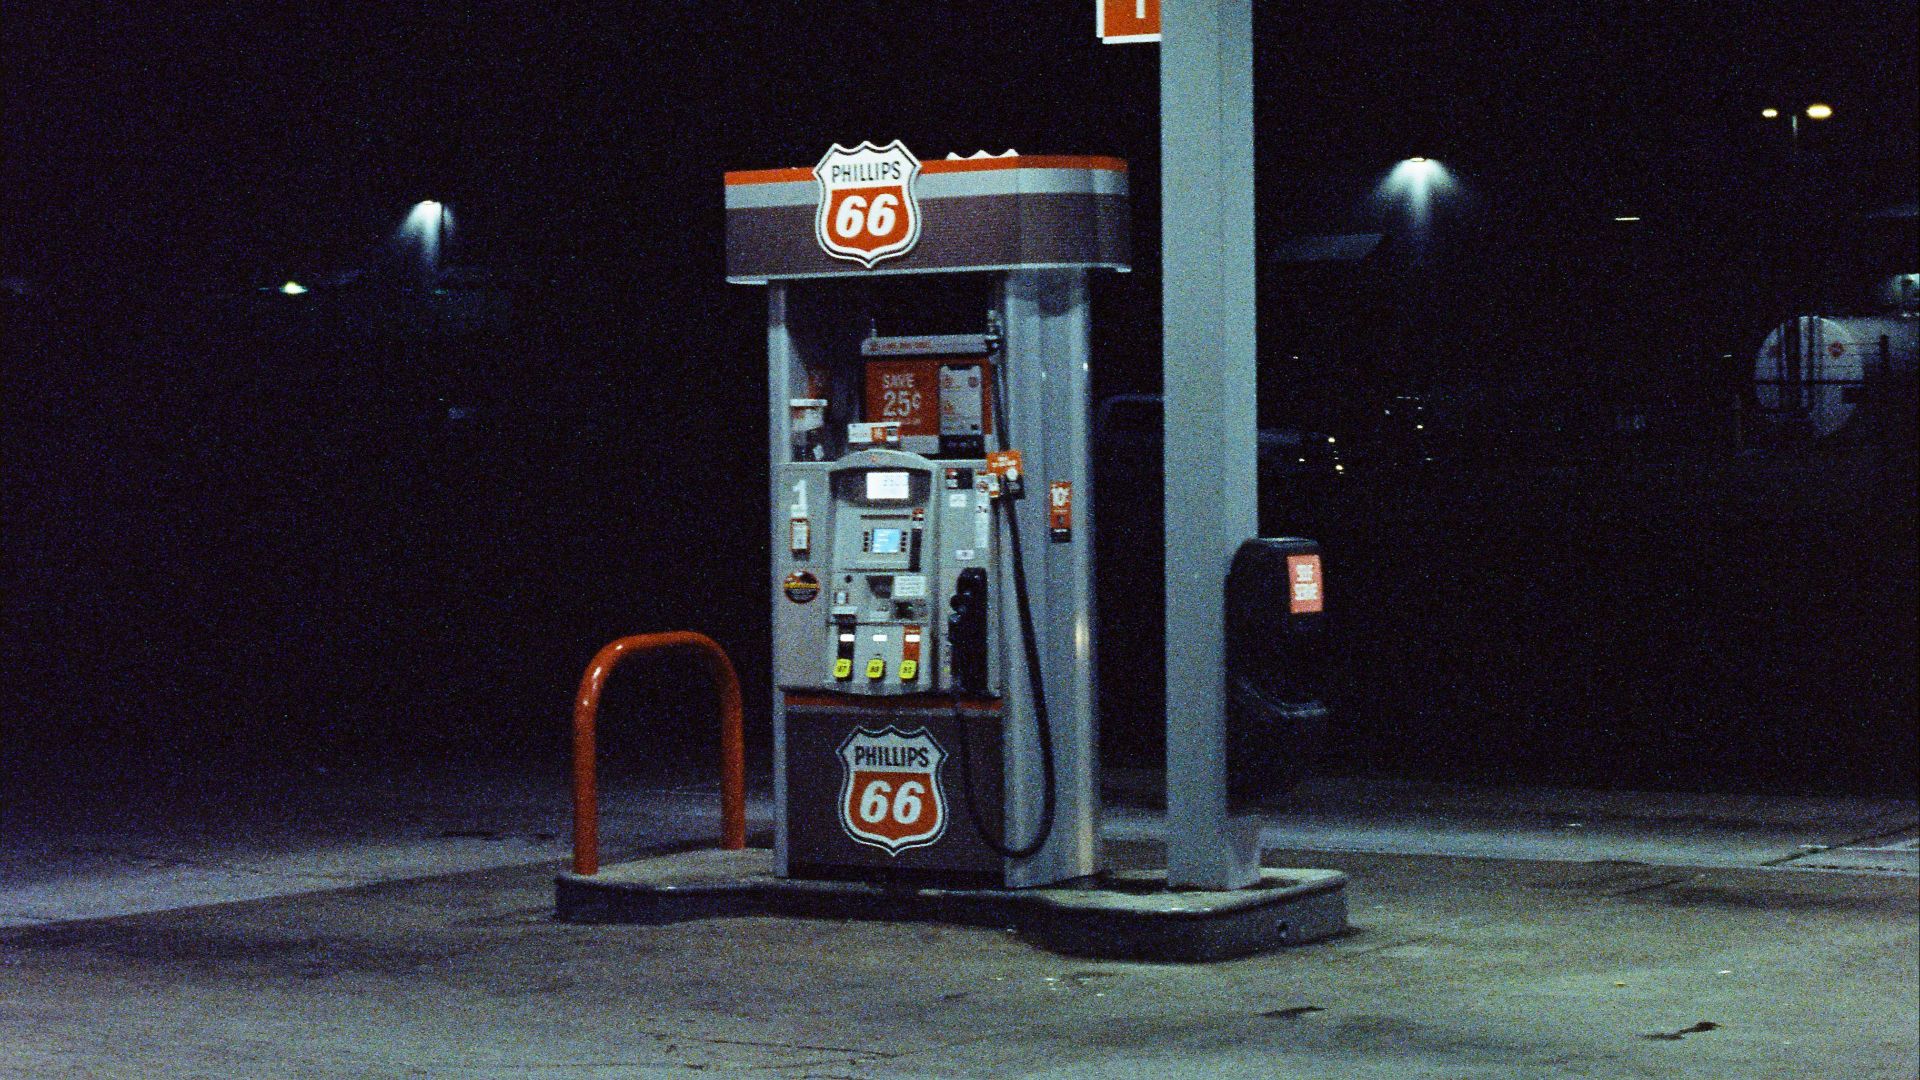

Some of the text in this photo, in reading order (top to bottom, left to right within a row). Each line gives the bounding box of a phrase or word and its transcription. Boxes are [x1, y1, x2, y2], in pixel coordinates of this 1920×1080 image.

[831, 160, 902, 184] PHILLIPS
[835, 193, 898, 239] 66
[881, 373, 915, 389] SAVE
[790, 479, 808, 514] 1
[854, 745, 930, 768] PHILLIPS
[859, 779, 926, 825] 66
